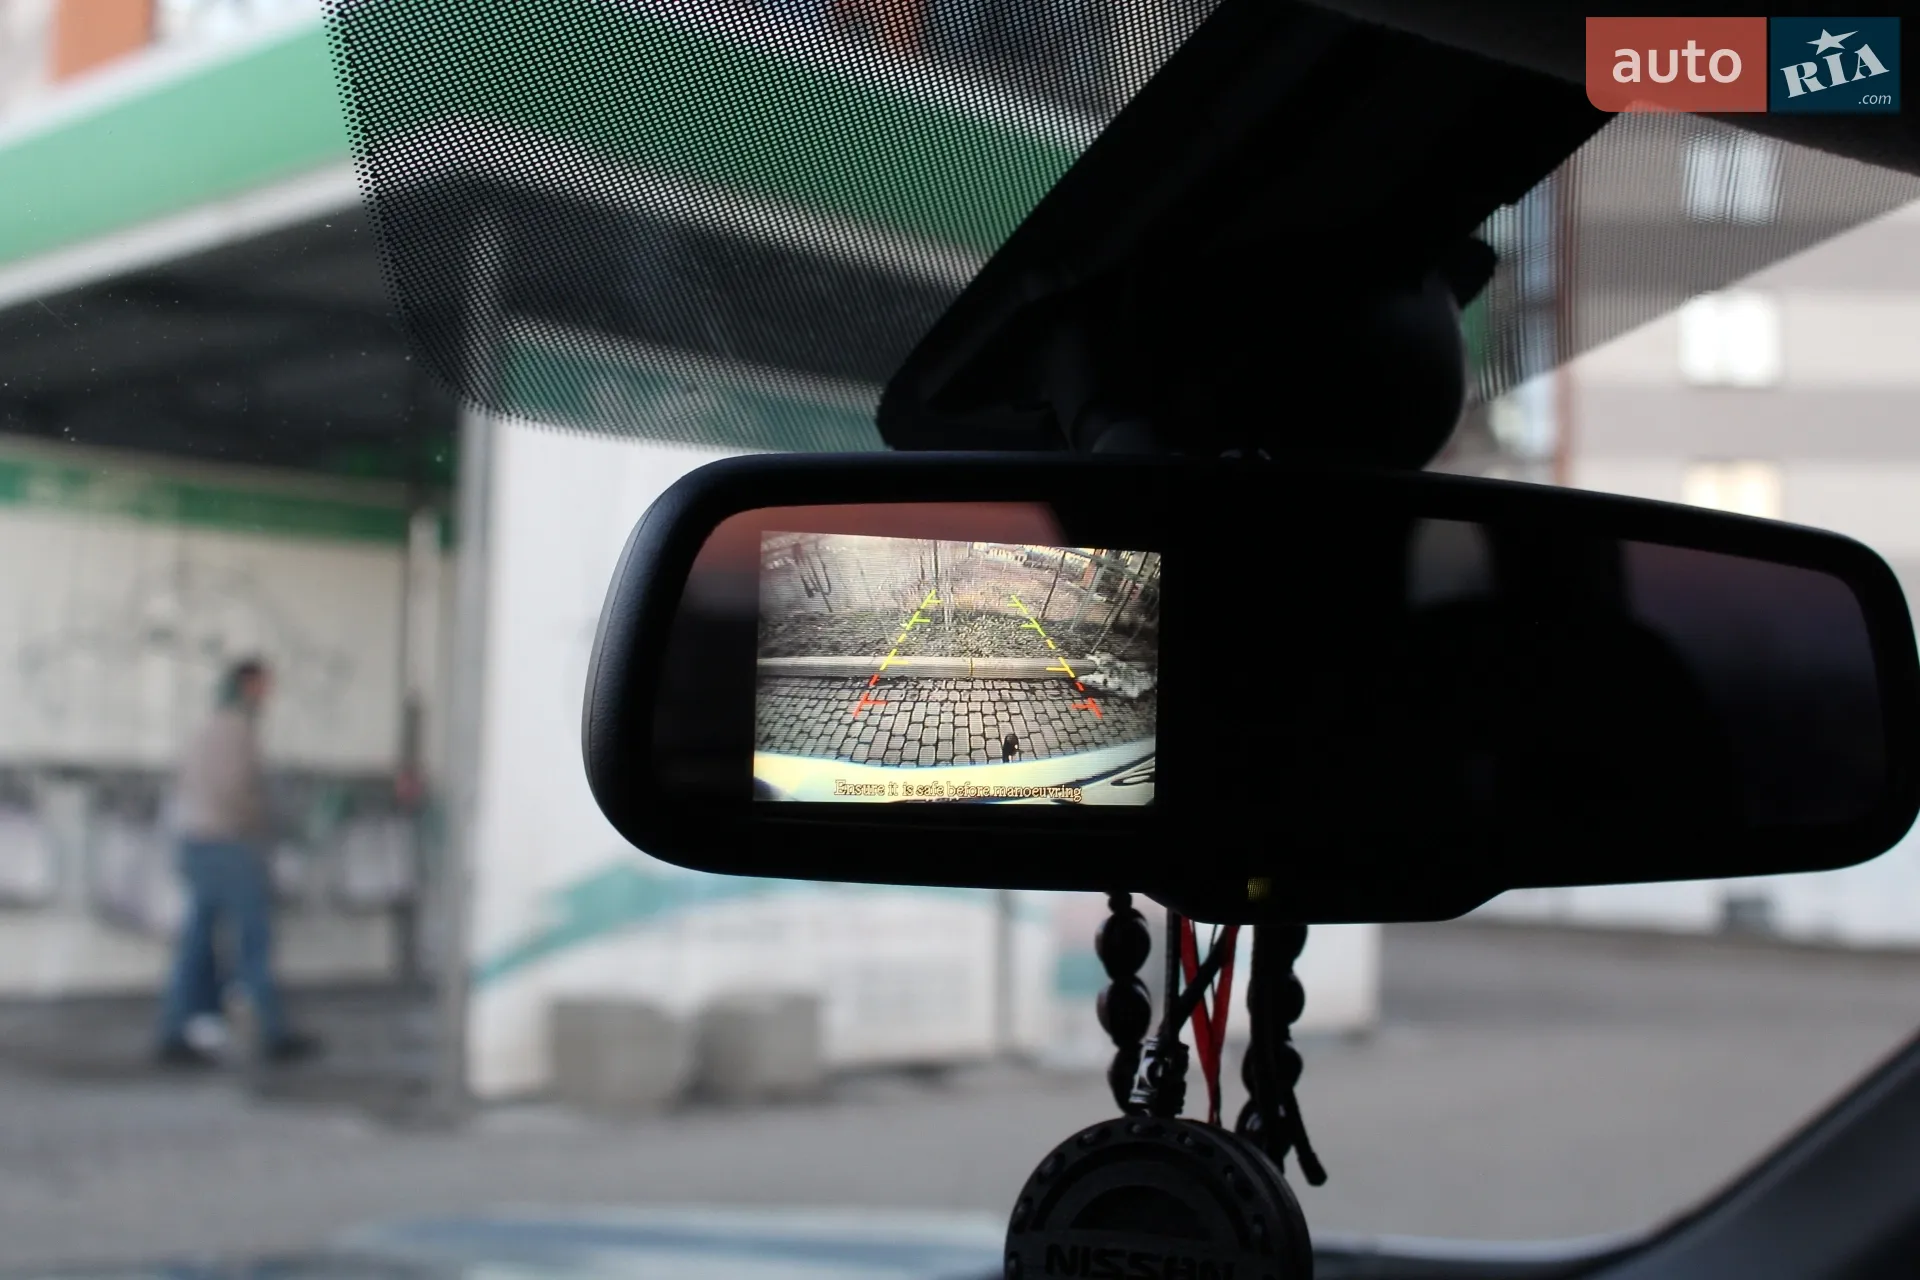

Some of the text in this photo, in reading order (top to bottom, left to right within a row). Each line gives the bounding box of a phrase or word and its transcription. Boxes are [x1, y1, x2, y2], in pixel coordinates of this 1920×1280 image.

[834, 779, 1082, 802] Ensure it is safe before manoeuvring
[1044, 1243, 1236, 1280] NISSAN
